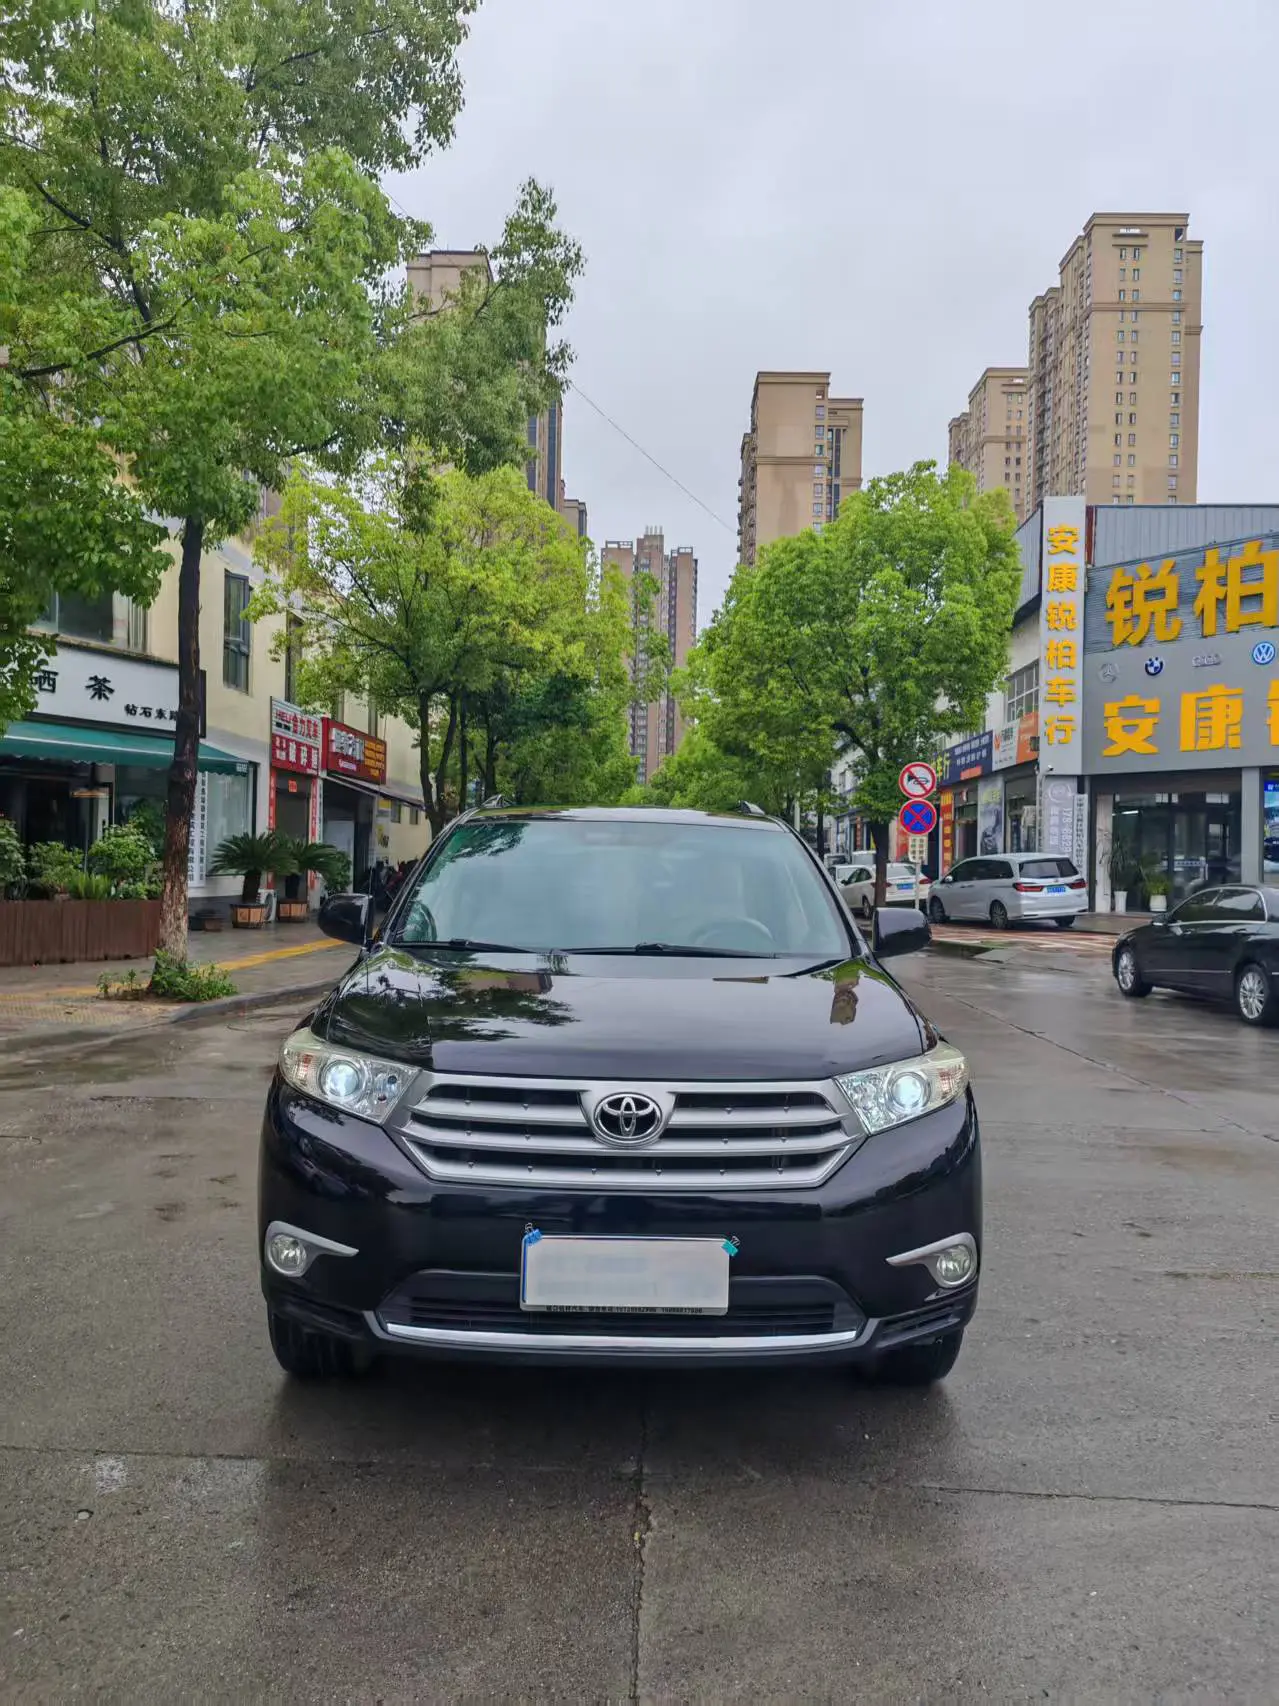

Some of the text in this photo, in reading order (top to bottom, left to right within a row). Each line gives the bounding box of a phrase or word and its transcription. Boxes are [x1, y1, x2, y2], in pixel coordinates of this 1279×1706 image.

[1045, 524, 1079, 746] 安康锐柏车行
[1102, 679, 1279, 757] 安康
